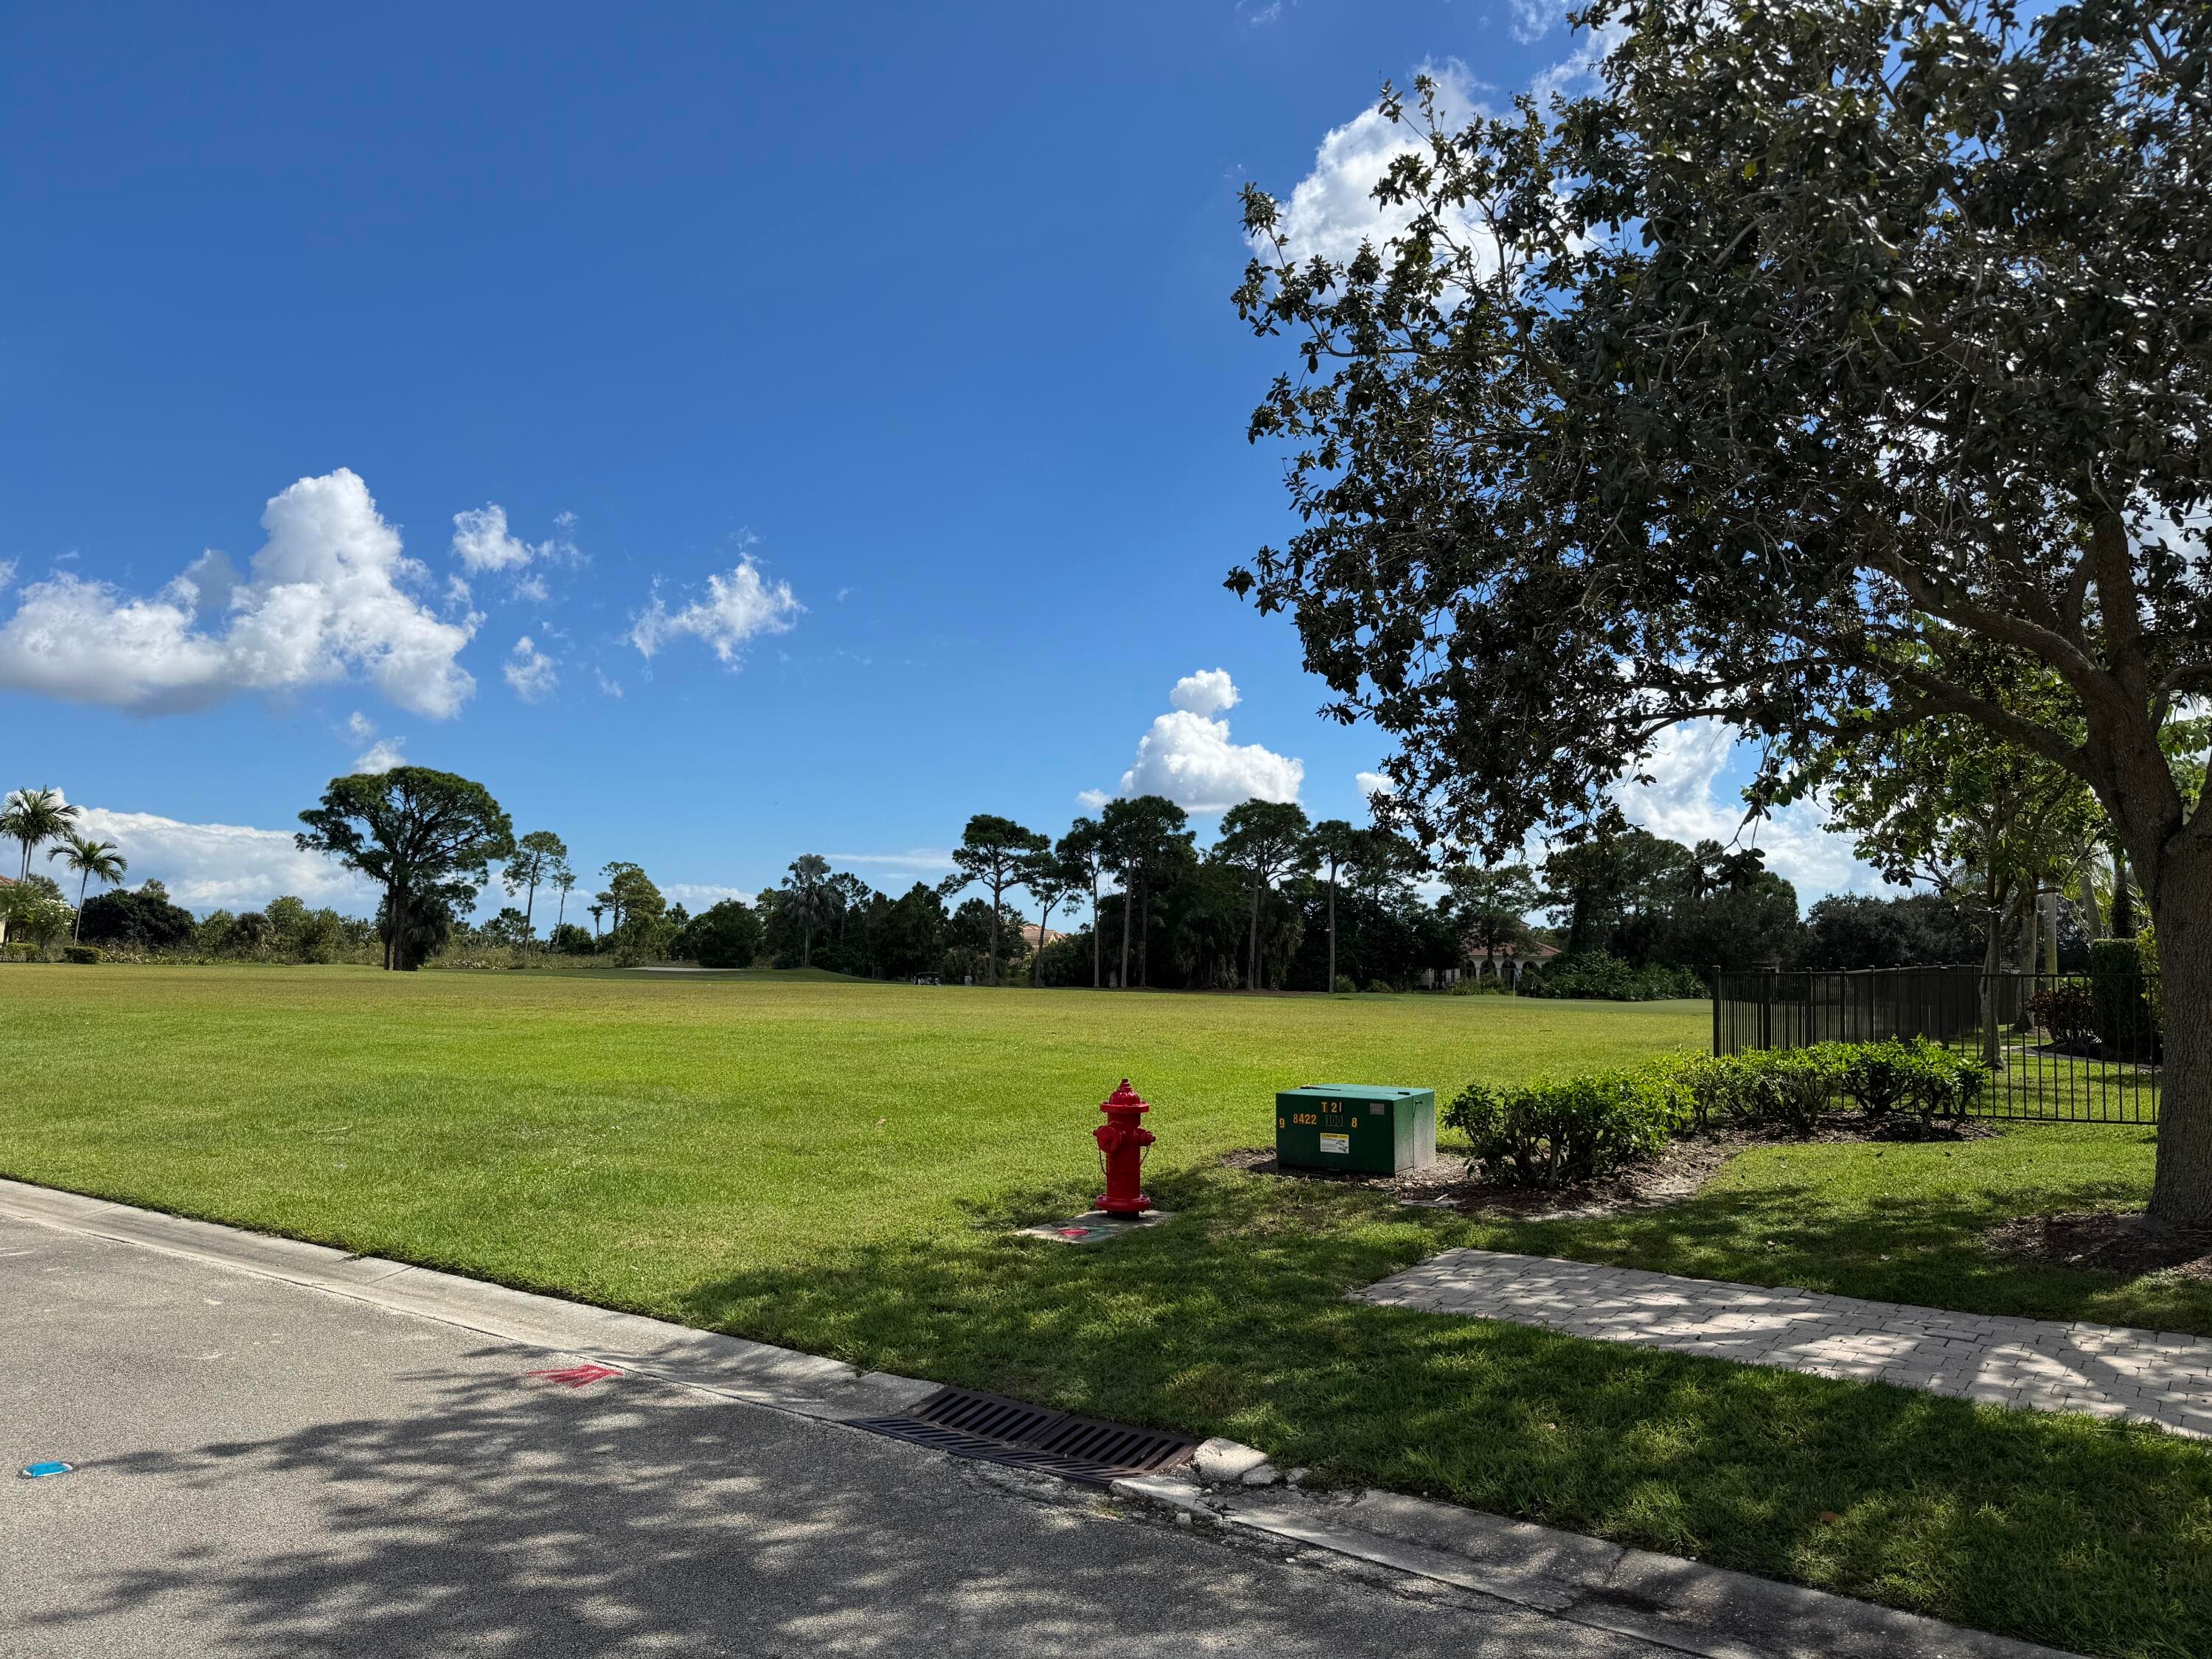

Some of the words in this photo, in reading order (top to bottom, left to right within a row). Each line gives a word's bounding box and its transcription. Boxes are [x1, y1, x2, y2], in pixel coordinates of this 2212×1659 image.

[1279, 1118, 1285, 1128] 9
[1293, 1113, 1318, 1125] 8422
[1326, 1115, 1342, 1125] 100
[1352, 1117, 1357, 1128] 8
